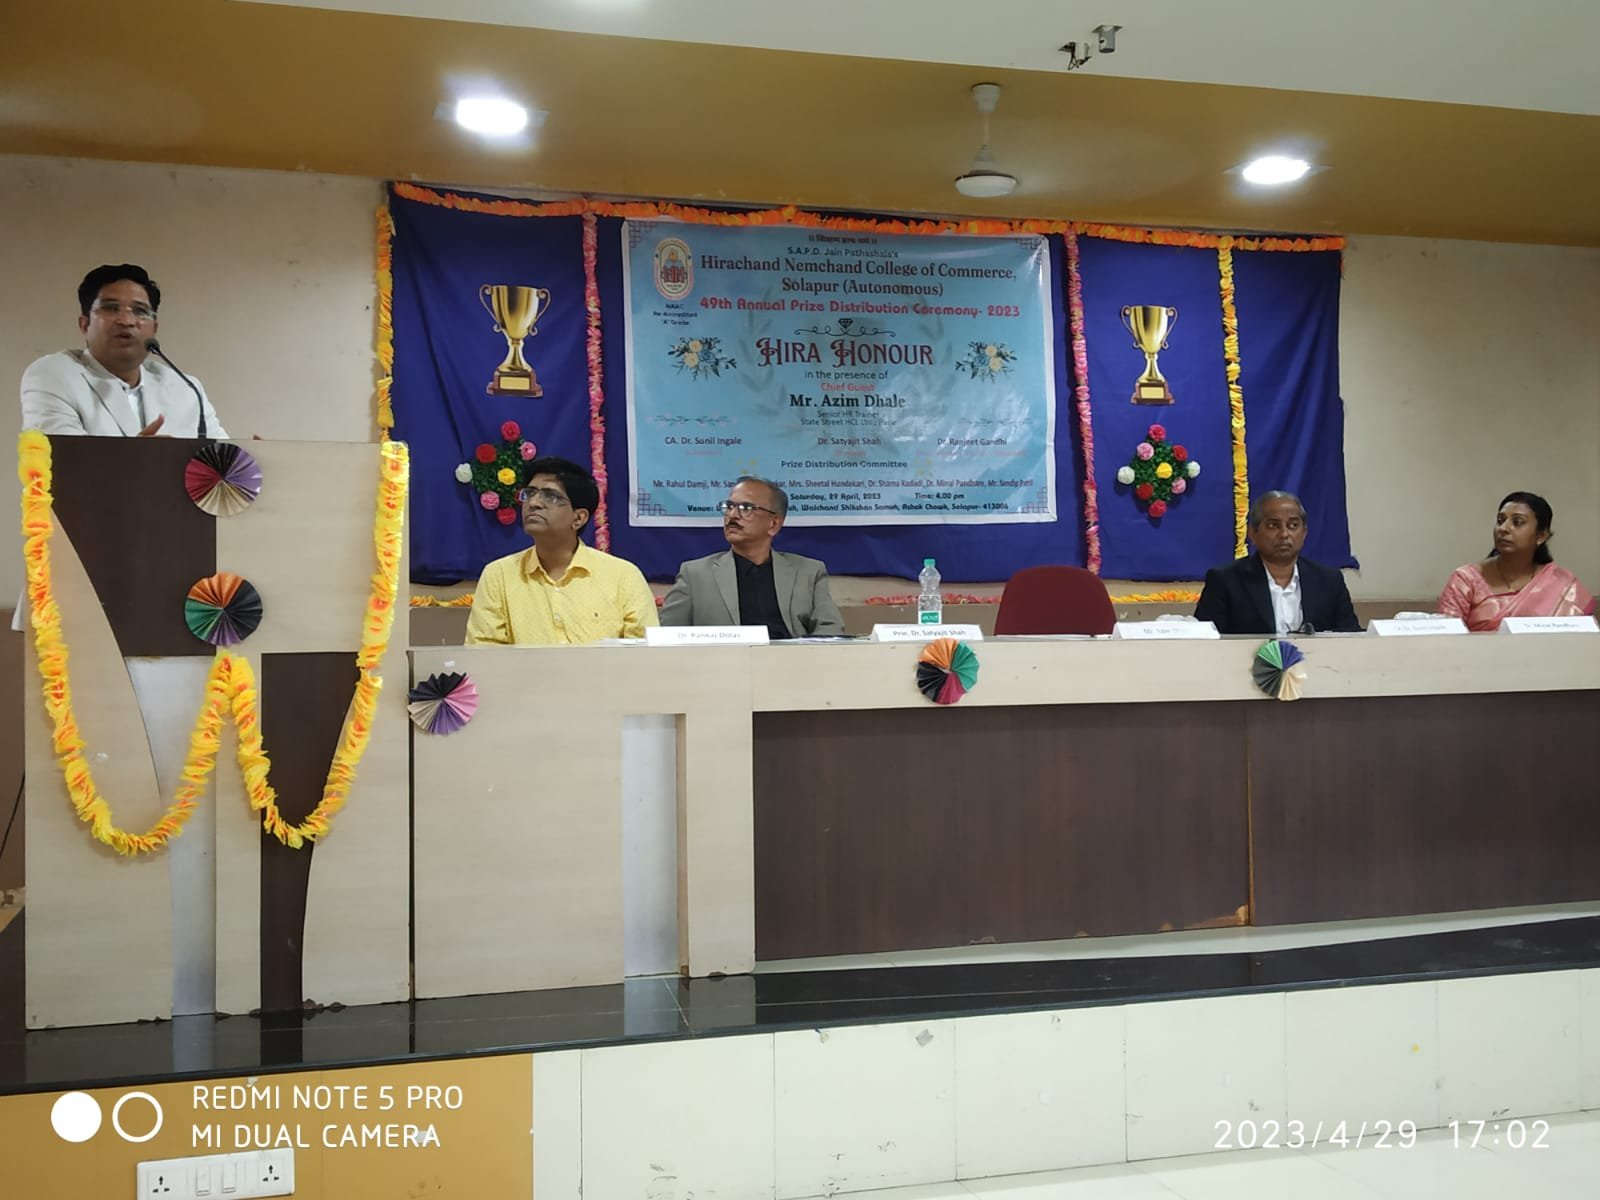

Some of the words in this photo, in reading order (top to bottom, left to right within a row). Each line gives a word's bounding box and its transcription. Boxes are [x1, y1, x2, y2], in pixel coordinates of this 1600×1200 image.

[824, 248, 842, 256] Jain
[701, 255, 780, 272] Hirachand
[784, 258, 862, 274] Nemchand
[866, 260, 918, 276] College
[921, 263, 935, 276] of
[938, 264, 1017, 281] Commerce,
[782, 277, 839, 296] Solapur
[843, 279, 944, 297] (Autonomous)
[700, 297, 732, 310] 49th
[737, 298, 786, 311] Annual
[790, 299, 824, 312] Prize
[830, 301, 908, 314] Distribution
[987, 305, 1020, 317] 2023
[756, 337, 822, 368] HIRA
[830, 338, 934, 368] HONOUR
[804, 370, 814, 380] in
[816, 371, 832, 380] the
[834, 372, 876, 382] presence
[878, 371, 888, 380] of
[820, 382, 846, 392] Chief
[847, 383, 876, 392] Guest
[790, 394, 817, 408] Mr.
[821, 394, 860, 408] Azim
[864, 394, 906, 408] Dhale
[664, 436, 679, 445] CA.
[681, 437, 692, 445] Dr.
[695, 436, 716, 446] Sunil
[717, 436, 742, 447] Ingale
[818, 437, 829, 446] Dr.
[831, 438, 860, 448] Satyajit
[862, 438, 882, 446] Shah
[980, 438, 1008, 446] Gandhi
[780, 460, 803, 468] Prize
[805, 459, 858, 468] Distribution
[860, 460, 908, 468] Committee
[653, 480, 664, 488] Mr.
[666, 480, 686, 488] Rahul
[711, 480, 722, 488] Mr.
[805, 480, 830, 488] Sheetal
[790, 493, 827, 501] Saturday,
[840, 493, 861, 501] April,
